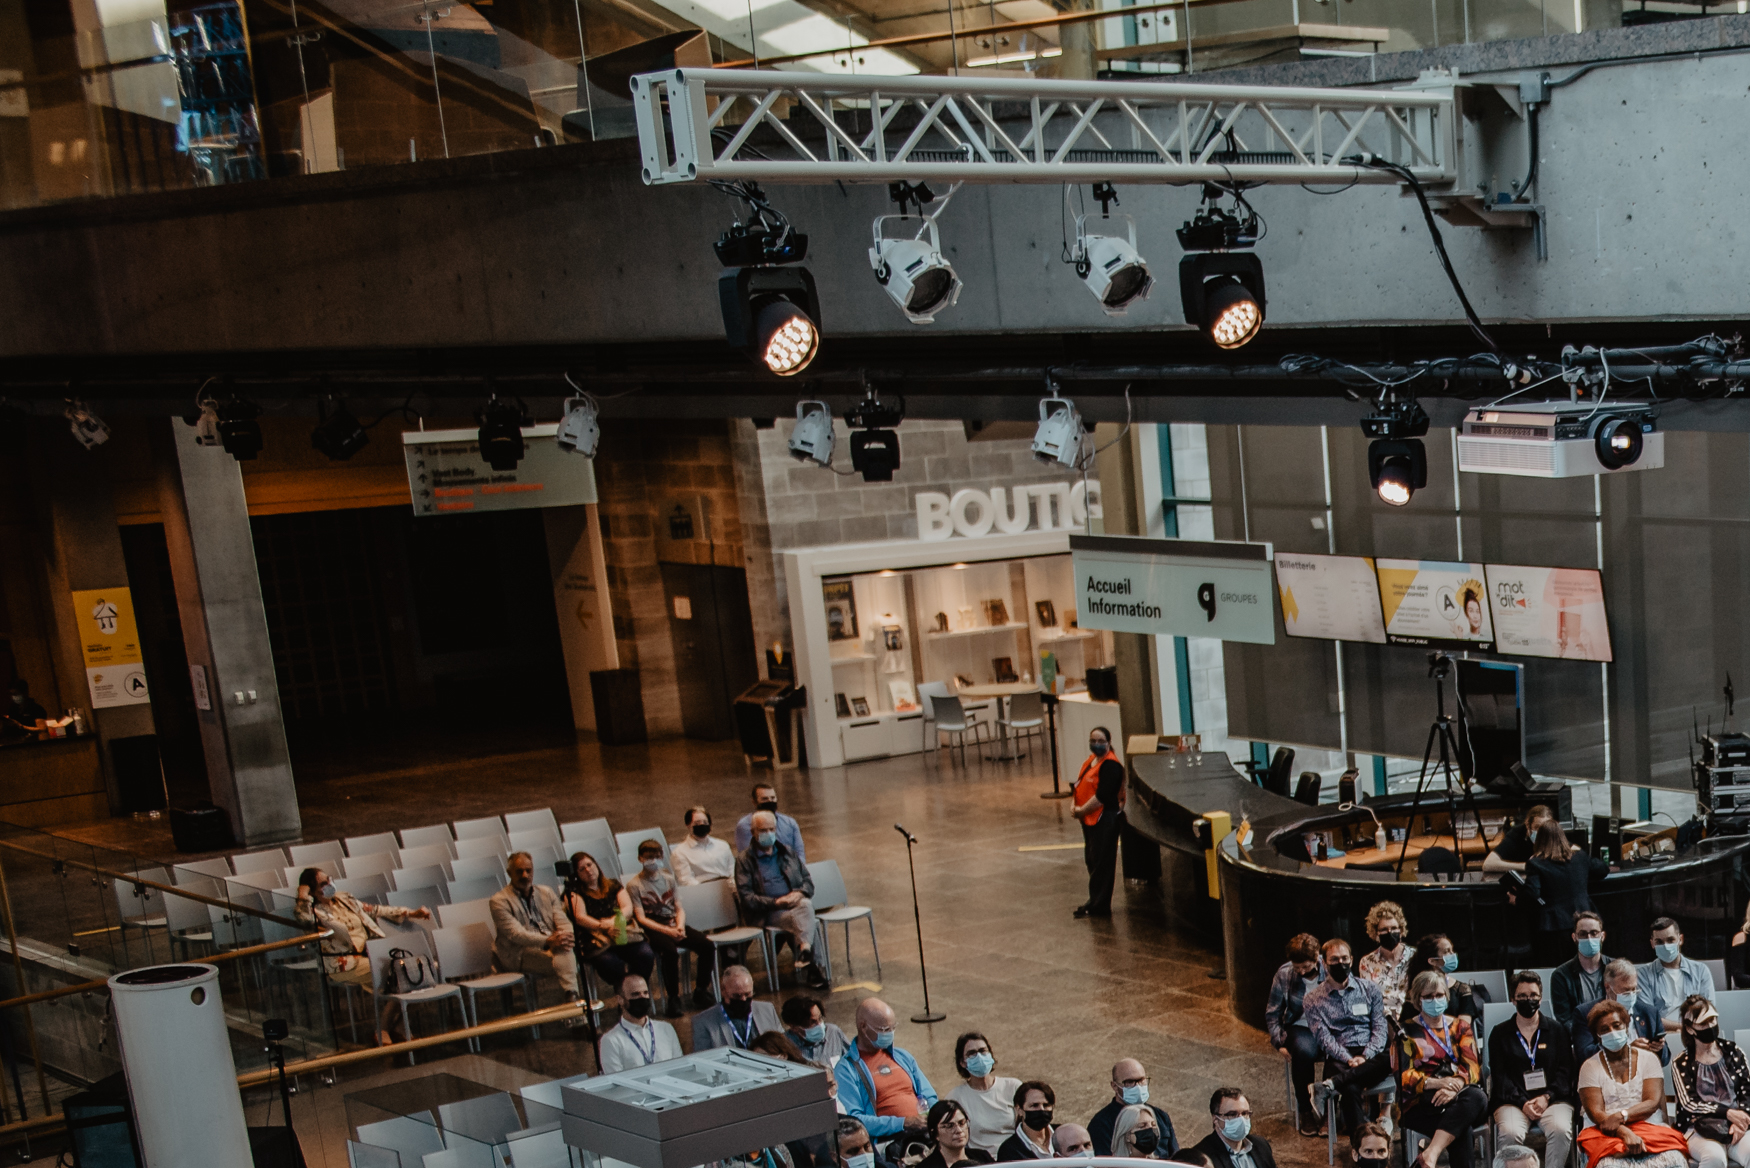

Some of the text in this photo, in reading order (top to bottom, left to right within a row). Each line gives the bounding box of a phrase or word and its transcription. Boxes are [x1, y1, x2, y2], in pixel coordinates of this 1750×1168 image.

[1279, 560, 1316, 571] Billetterie
[1087, 576, 1131, 595] Accueil
[1498, 580, 1524, 594] mot
[1220, 592, 1258, 605] GROUPES
[1444, 594, 1455, 611] A
[1500, 594, 1516, 608] dit
[1088, 597, 1162, 619] Information
[133, 678, 145, 692] A
